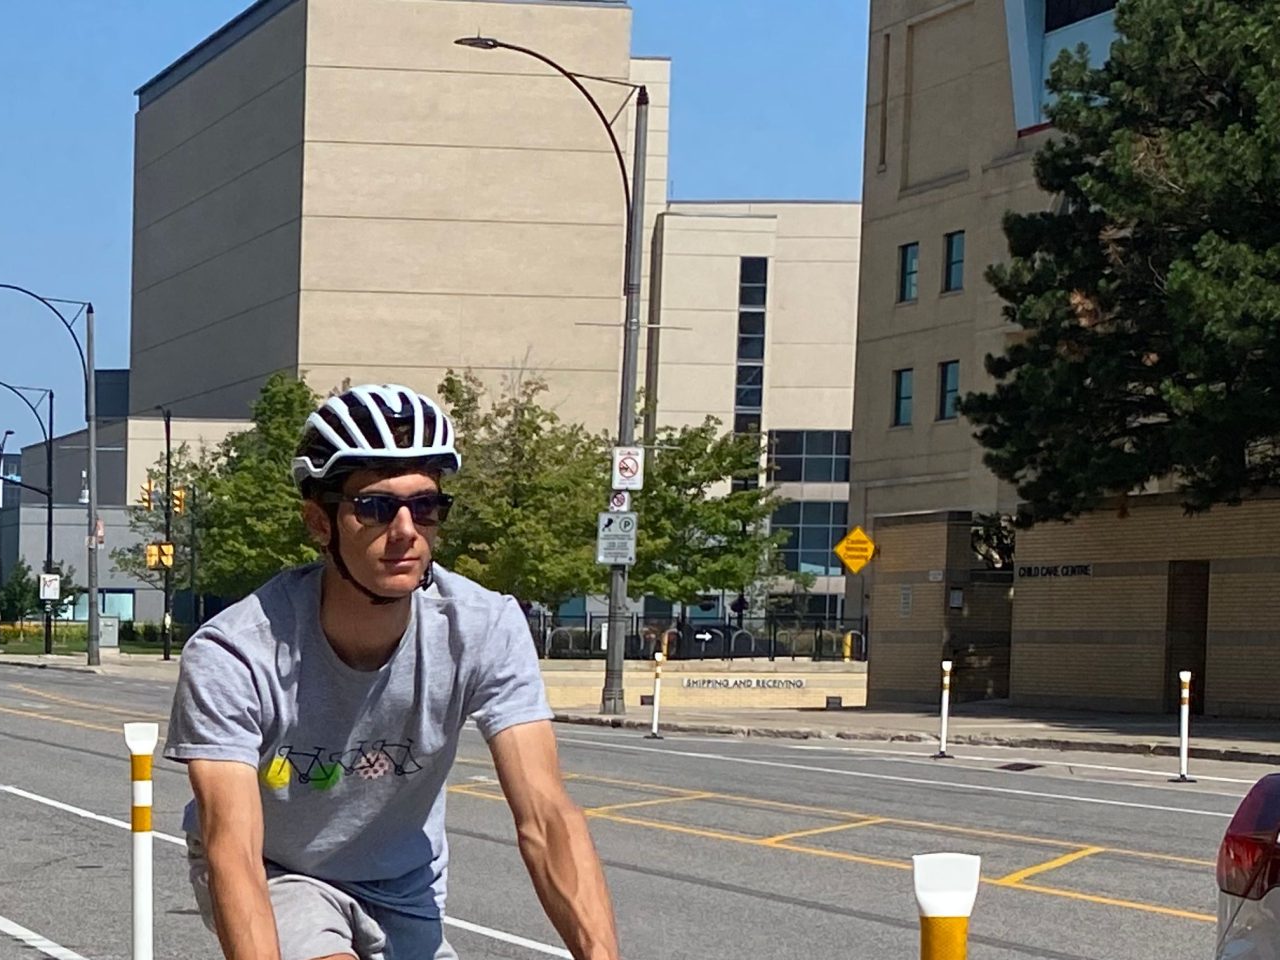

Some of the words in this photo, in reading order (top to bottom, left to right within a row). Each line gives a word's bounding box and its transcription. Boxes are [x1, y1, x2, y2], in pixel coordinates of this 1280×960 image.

[1019, 566, 1040, 577] CHILD
[1041, 566, 1060, 577] CARE
[1061, 565, 1091, 576] CENTRE
[686, 679, 729, 688] SHIPPING
[732, 679, 753, 688] AND
[756, 679, 804, 688] RECEIVING
